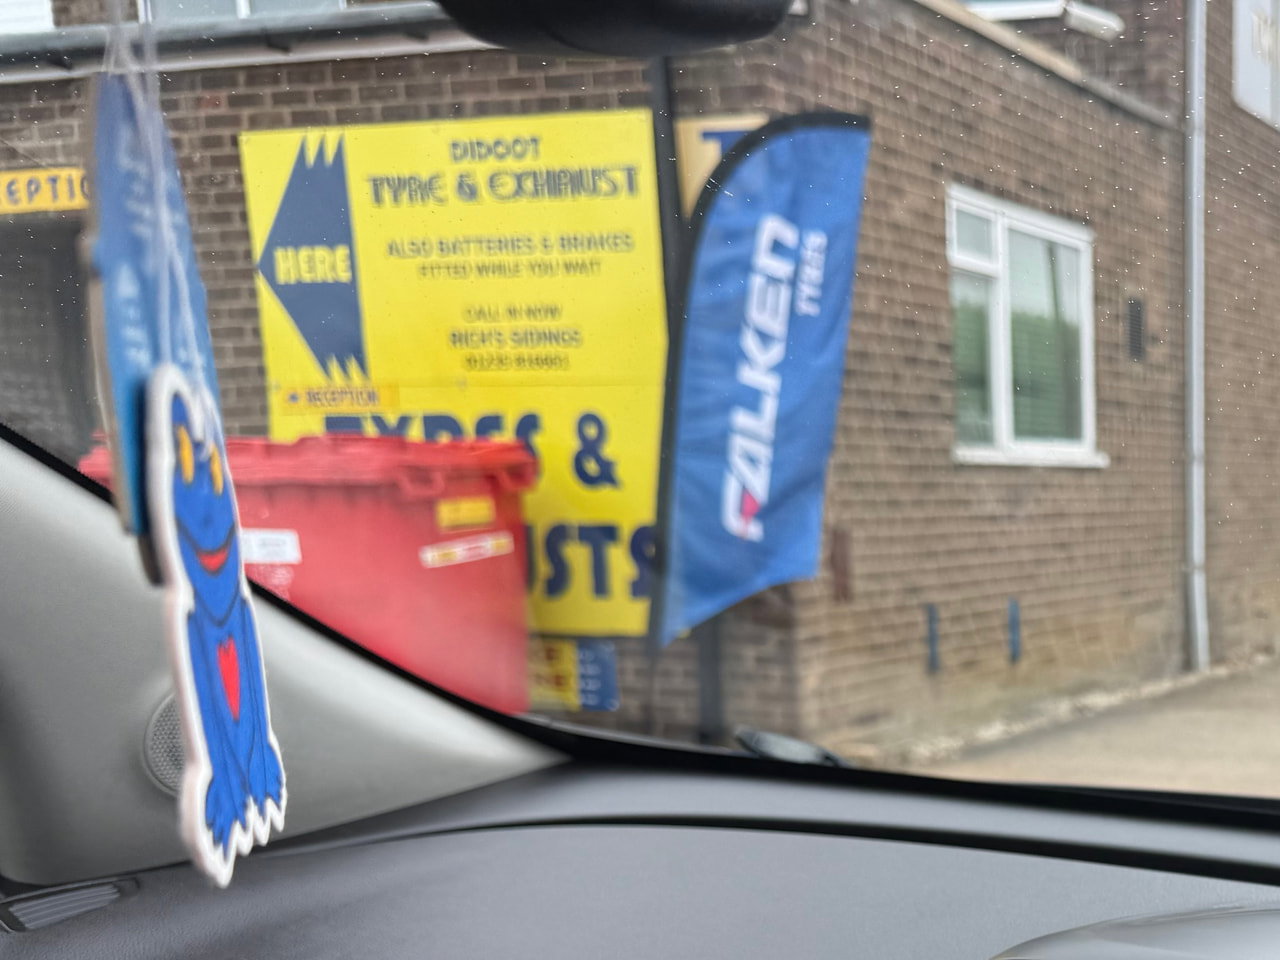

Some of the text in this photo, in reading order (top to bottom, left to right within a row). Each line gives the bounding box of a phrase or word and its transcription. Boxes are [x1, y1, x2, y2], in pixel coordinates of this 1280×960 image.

[456, 172, 478, 201] &
[488, 165, 638, 201] EXHAUST
[273, 246, 352, 285] HERE
